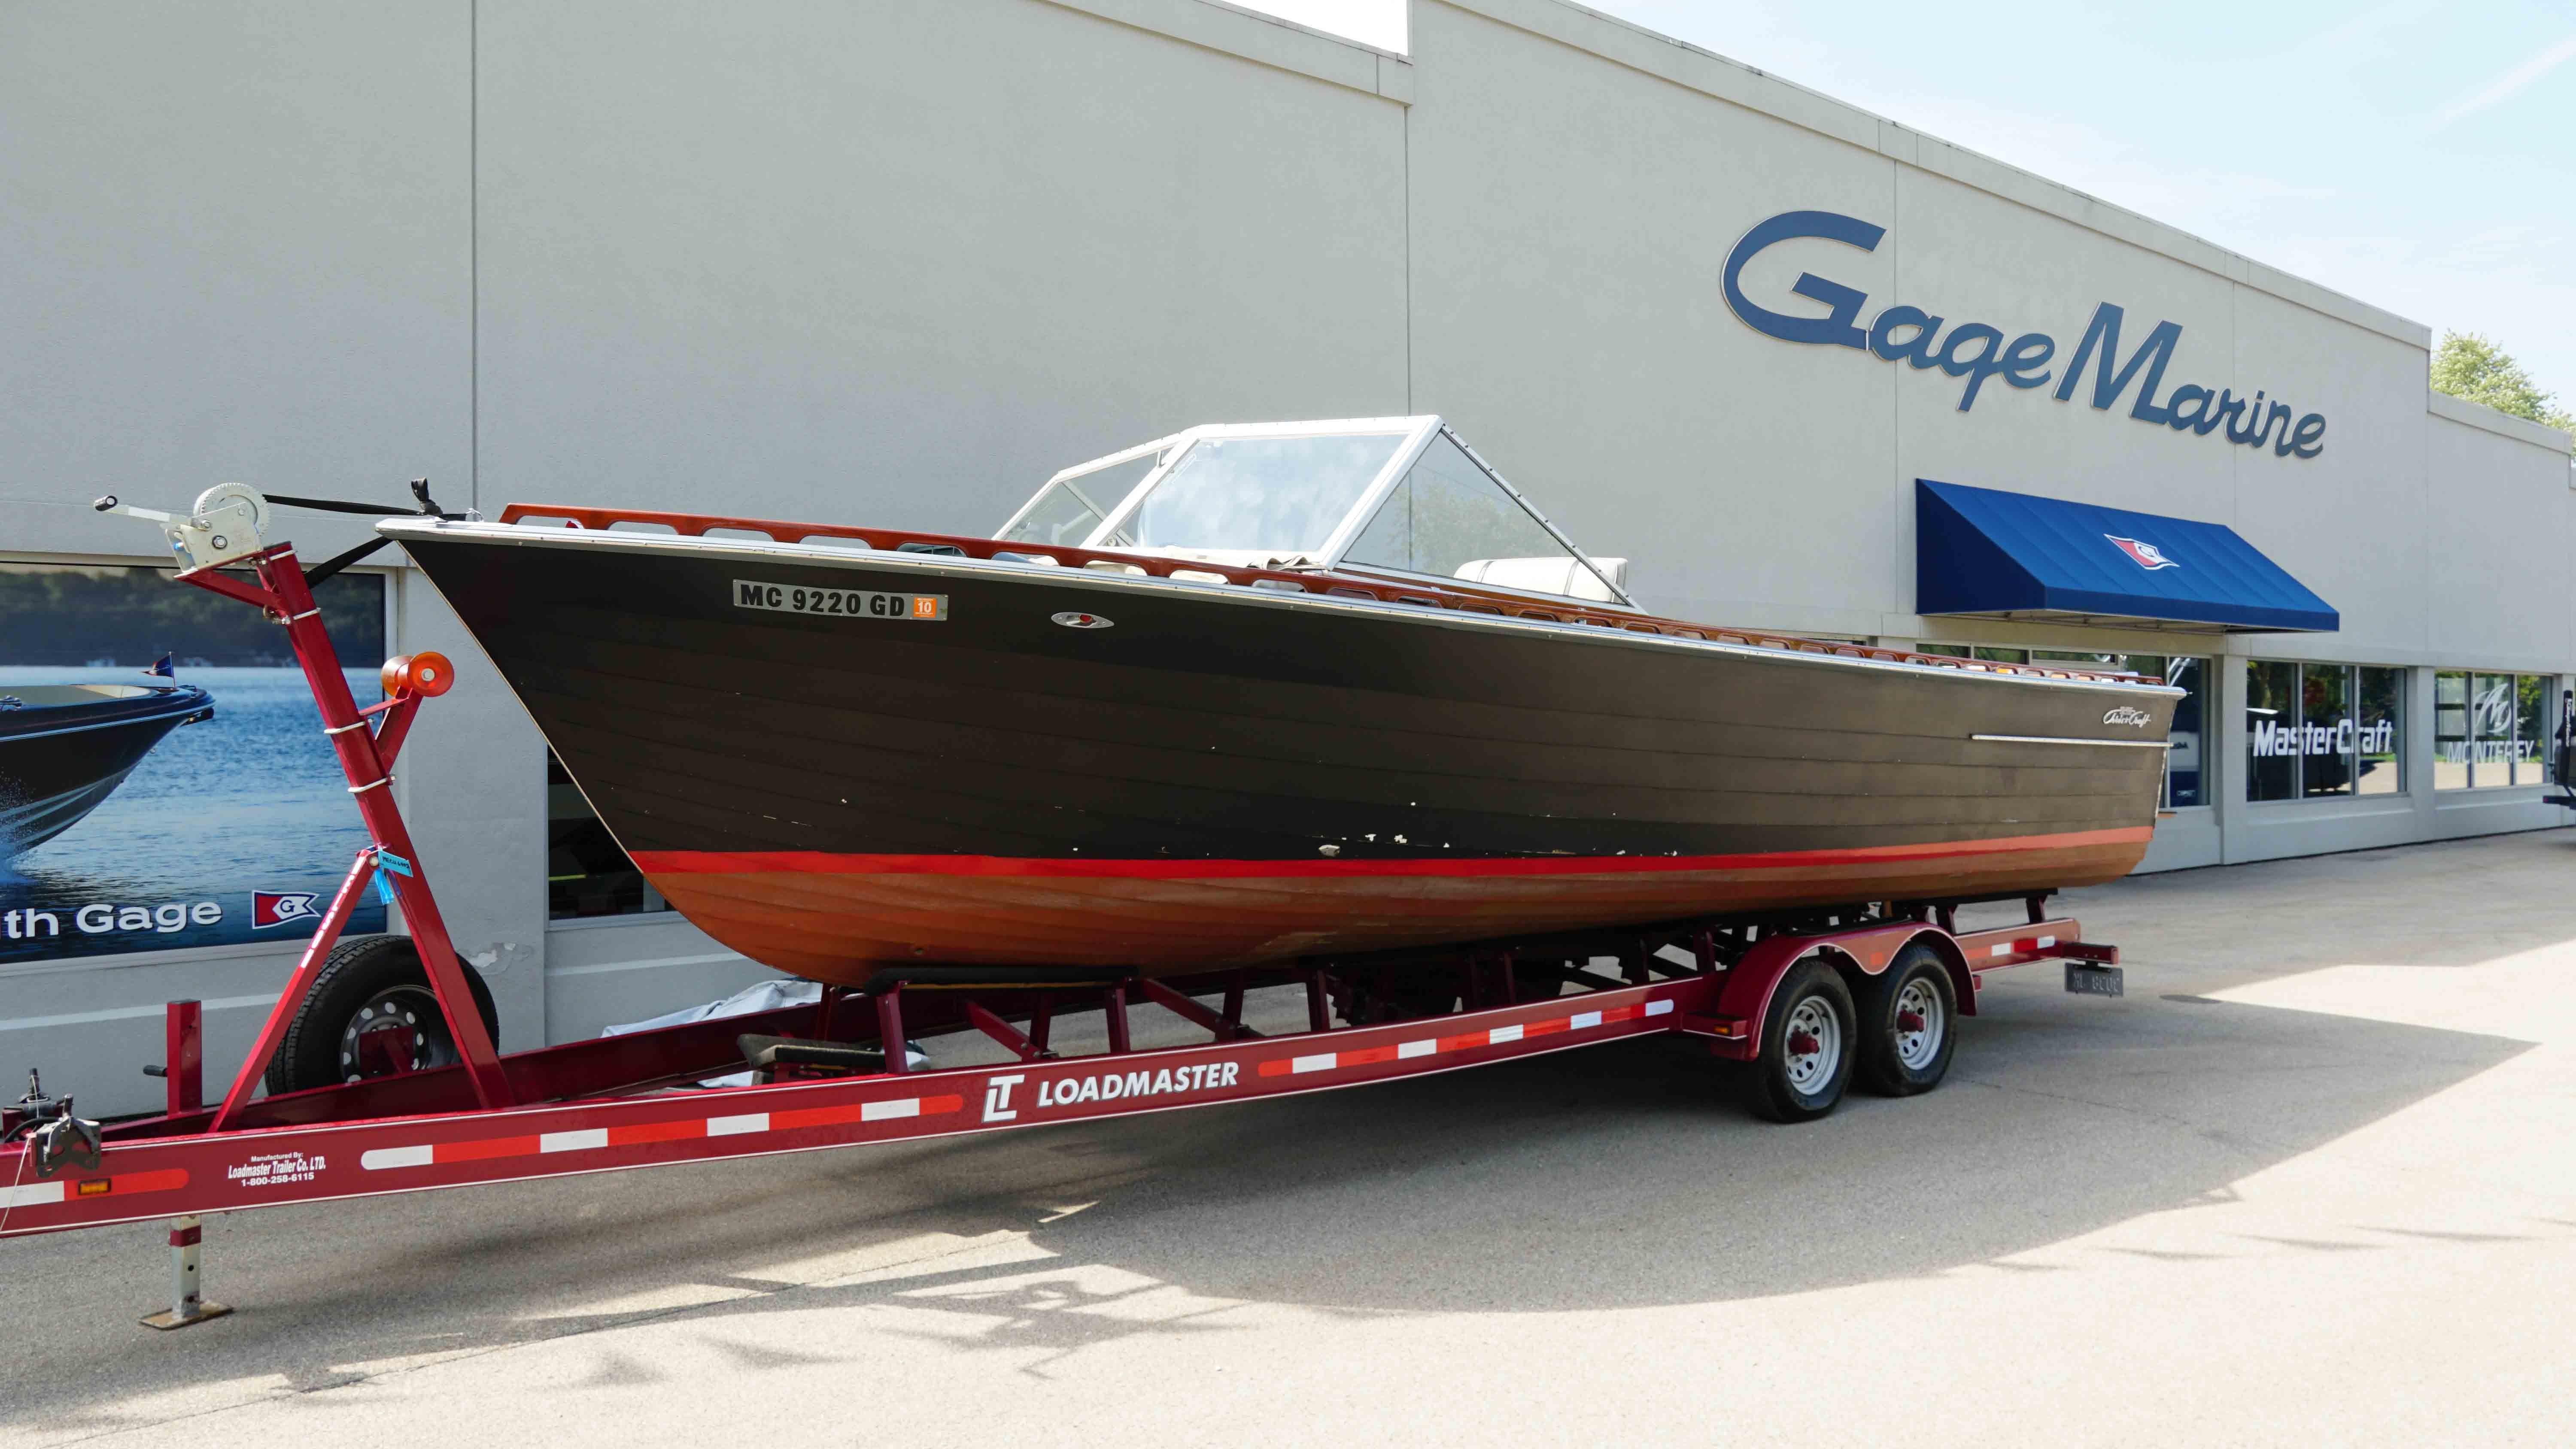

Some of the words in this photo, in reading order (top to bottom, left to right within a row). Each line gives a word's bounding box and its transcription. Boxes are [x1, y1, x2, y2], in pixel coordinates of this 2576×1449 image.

[1721, 209, 2056, 414] Gage
[2053, 301, 2327, 459] Marine
[741, 584, 782, 607] MC
[793, 589, 861, 614] 9220
[870, 594, 905, 616] GD
[918, 601, 932, 613] 10
[2253, 719, 2393, 757] MasterCraft
[2448, 740, 2534, 764] MONTEREY
[76, 901, 222, 934] Gage
[280, 900, 295, 913] G
[1037, 1061, 1239, 1107] LOADMASTER
[228, 1163, 271, 1179] Loadmaster
[273, 1160, 296, 1174] Trailer
[297, 1158, 308, 1172] Co.
[310, 1156, 326, 1170] LTD.
[251, 1152, 292, 1162] Manufactured
[241, 1172, 315, 1187] 1-800-258-6115
